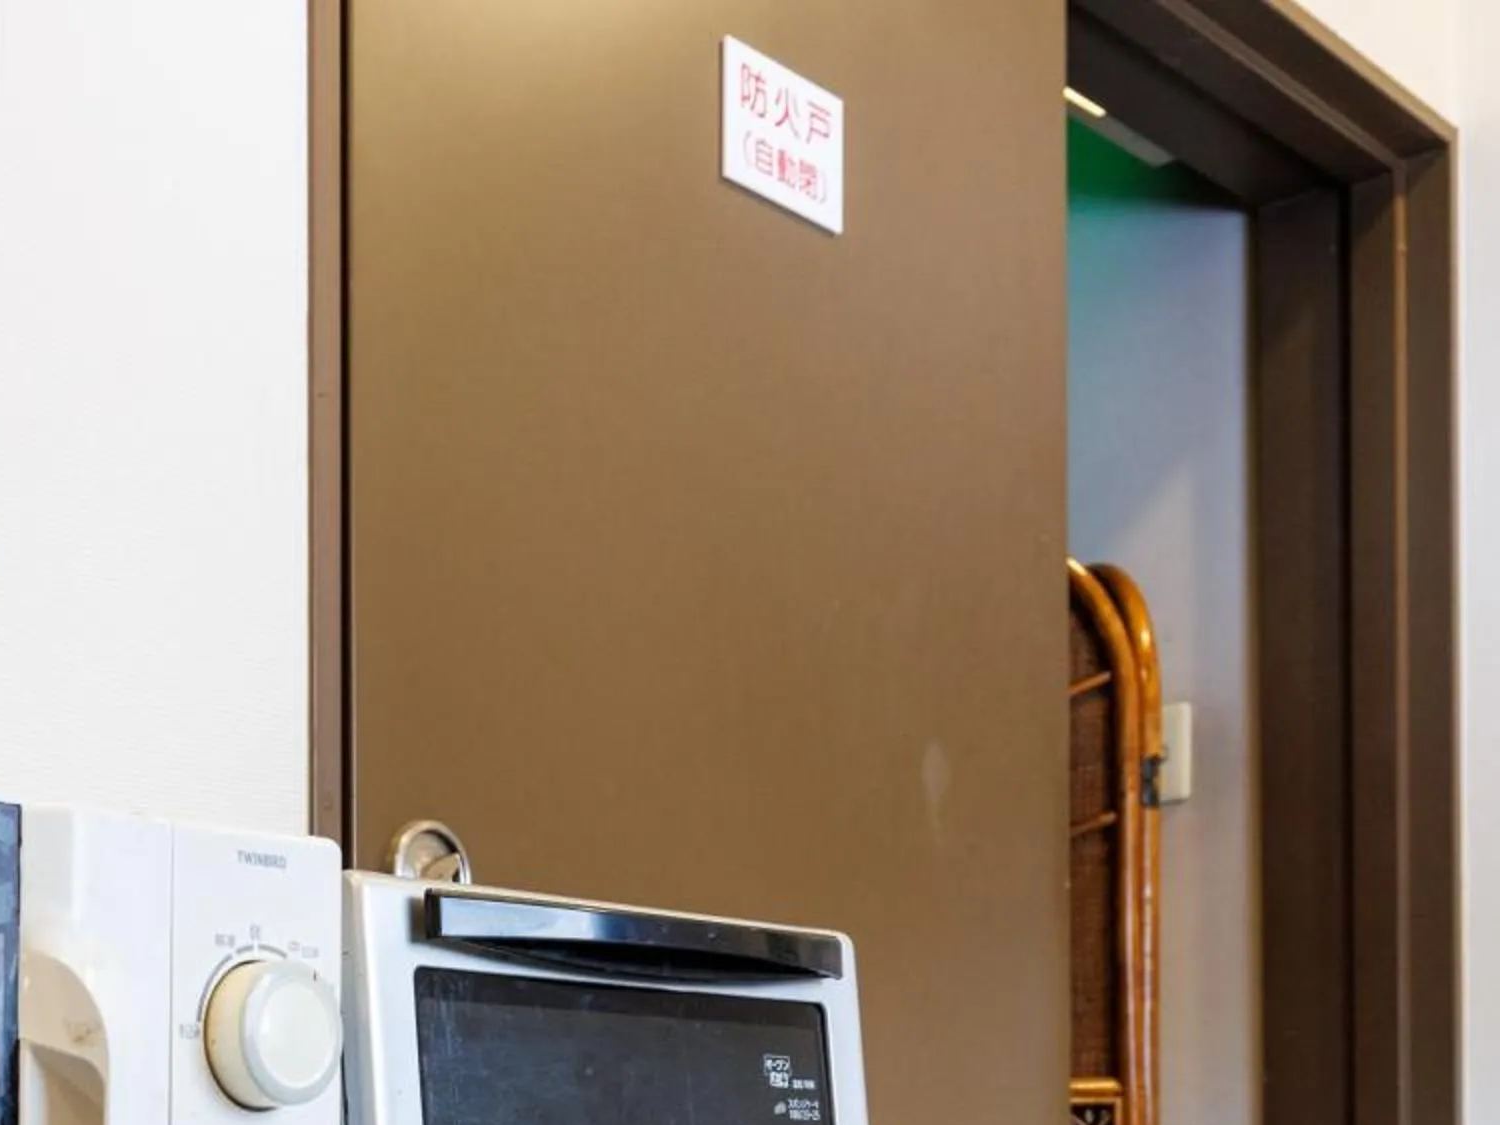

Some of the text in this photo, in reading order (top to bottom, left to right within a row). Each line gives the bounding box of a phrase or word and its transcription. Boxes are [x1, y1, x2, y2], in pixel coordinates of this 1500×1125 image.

[740, 62, 831, 145] 防火戸
[237, 850, 287, 869] TWINBIRD
